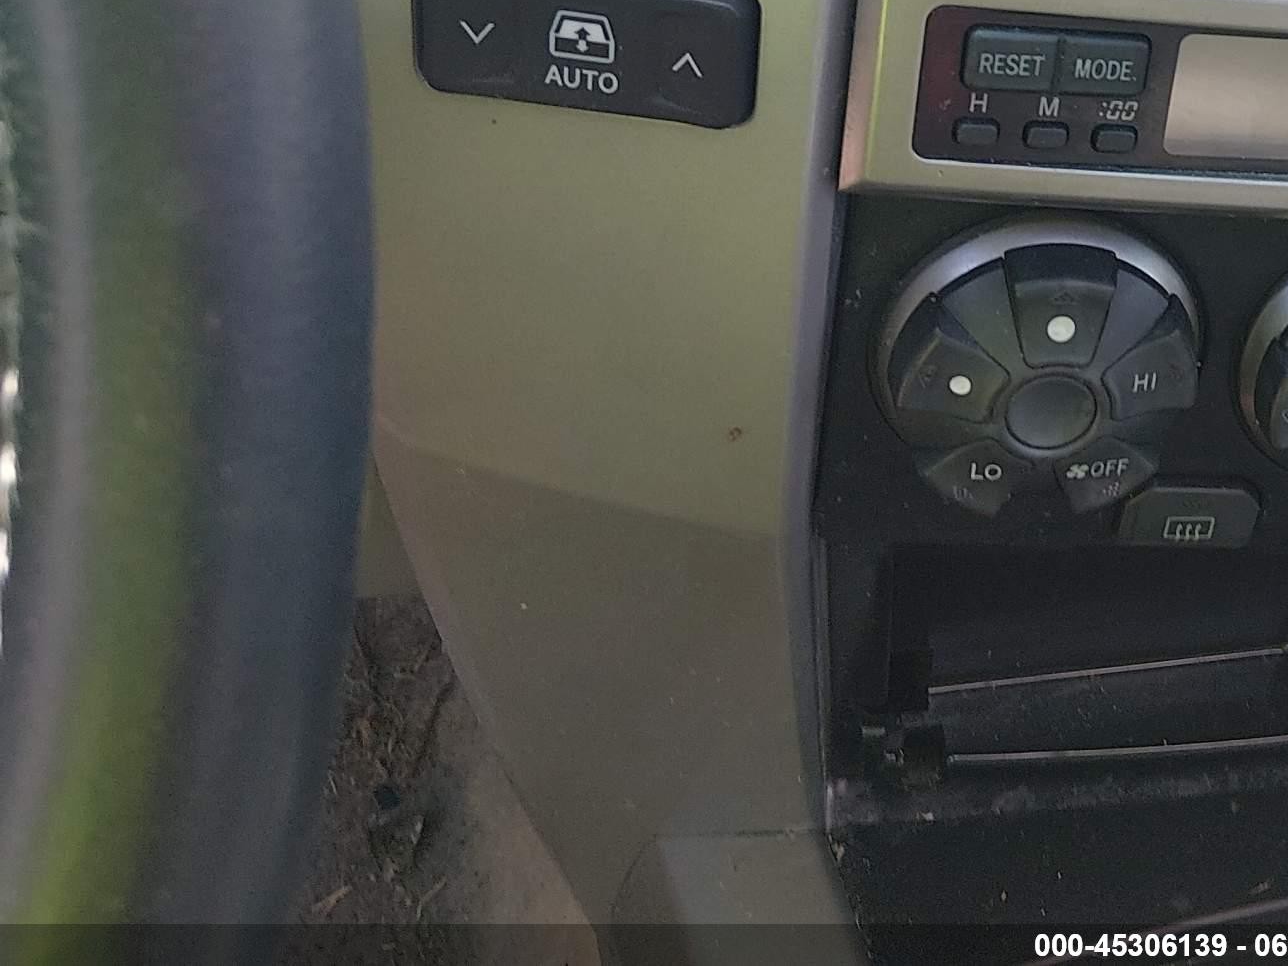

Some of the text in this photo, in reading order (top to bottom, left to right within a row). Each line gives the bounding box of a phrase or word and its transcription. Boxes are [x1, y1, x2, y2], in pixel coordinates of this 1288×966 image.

[978, 52, 1046, 77] RESET
[1074, 58, 1134, 82] MODE
[544, 64, 619, 94] AUTO
[968, 92, 989, 114] H
[1038, 96, 1060, 118] M
[1132, 372, 1158, 393] HI
[970, 462, 1002, 481] LO
[1089, 457, 1130, 477] OFF
